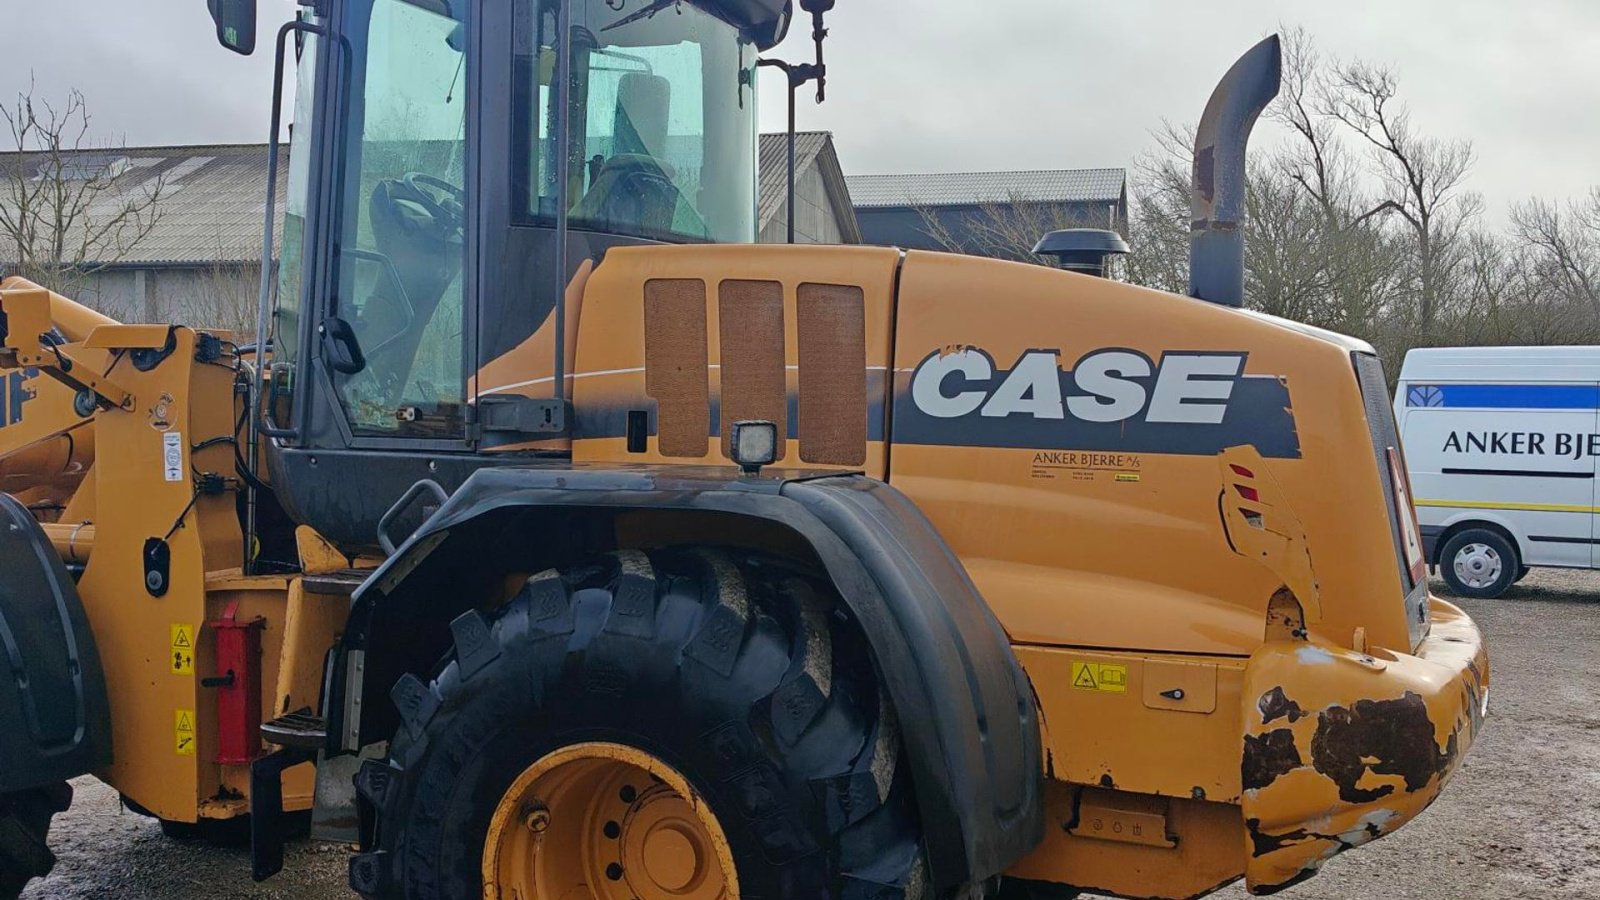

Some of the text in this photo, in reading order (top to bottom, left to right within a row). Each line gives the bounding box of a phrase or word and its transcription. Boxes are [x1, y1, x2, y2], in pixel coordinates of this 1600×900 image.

[911, 348, 1244, 424] CASE
[1032, 452, 1078, 465] ANKER
[1080, 453, 1124, 468] BJERRE
[1442, 431, 1600, 461] ANKER BJE
